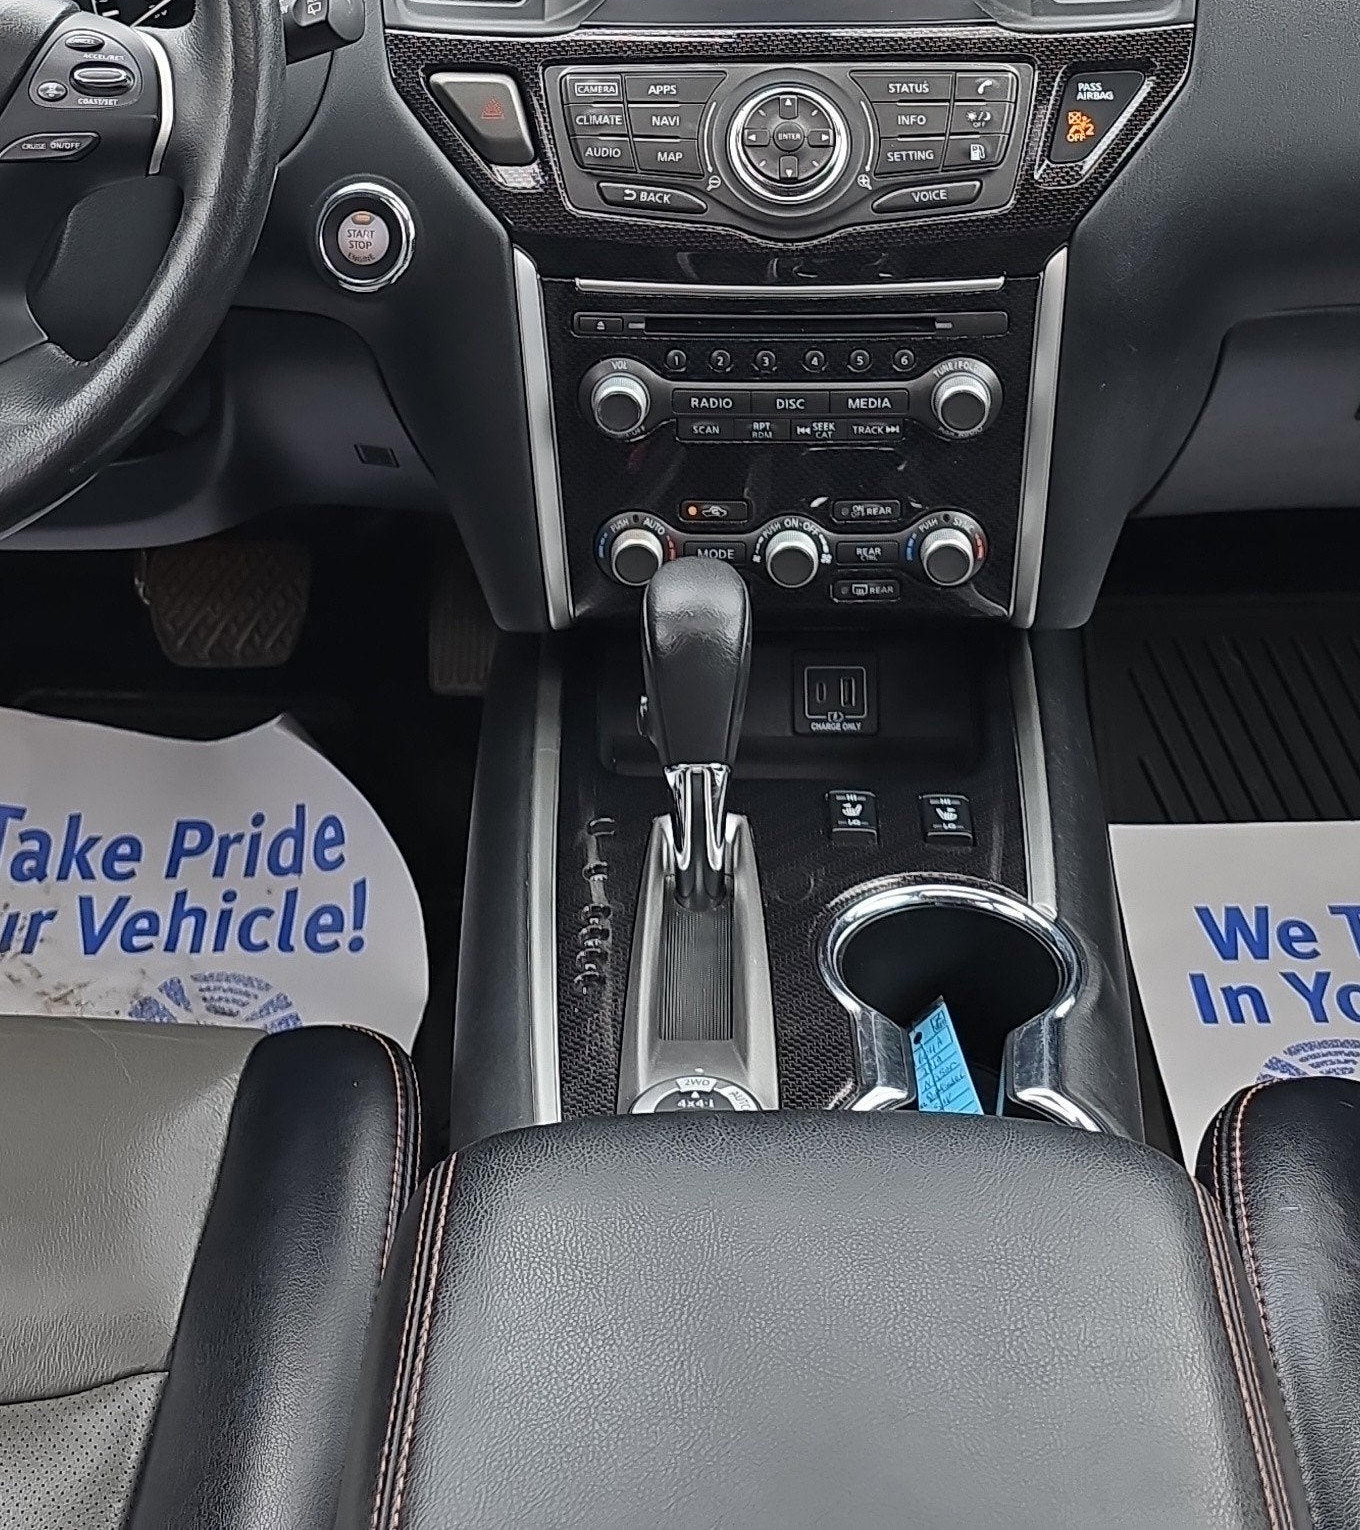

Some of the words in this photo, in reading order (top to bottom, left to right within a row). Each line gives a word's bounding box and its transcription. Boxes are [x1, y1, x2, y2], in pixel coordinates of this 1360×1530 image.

[577, 85, 615, 95] CAMERA
[648, 85, 677, 95] APPS
[888, 83, 929, 94] STATUS
[1077, 82, 1102, 91] PASS
[1076, 91, 1114, 101] AIRBAG
[576, 115, 622, 125] CLIMATE
[652, 116, 680, 126] NAVI
[897, 115, 926, 125] INFO
[778, 132, 801, 141] ENTER
[50, 142, 80, 150] ON/OFF
[585, 147, 621, 158] AUDIO
[657, 152, 683, 162] MAP
[887, 150, 934, 162] SETTING
[640, 192, 671, 204] BACK
[912, 190, 947, 202] VOICE
[347, 229, 375, 238] START
[349, 241, 372, 249] STOP
[611, 361, 627, 370] VOL
[674, 356, 679, 365] 1
[717, 356, 724, 366] 2
[763, 357, 770, 366] 3
[811, 356, 818, 366] 4
[857, 356, 863, 366] 5
[901, 356, 908, 366] 6
[690, 397, 733, 409] RADIO
[776, 398, 806, 409] DISC
[847, 397, 891, 409] MEDIA
[692, 425, 720, 434] SCAN
[752, 422, 770, 430] RPT
[812, 422, 835, 431] SEEK
[853, 425, 882, 435] TRACK
[815, 431, 832, 439] CAT
[866, 506, 892, 516] REAR
[610, 518, 629, 533] PUSH
[643, 518, 666, 535] AUTO
[762, 522, 781, 538] PUSH
[918, 518, 938, 532] PUSH
[697, 549, 734, 559] MODE
[856, 547, 881, 556] REAR
[869, 586, 894, 595] REAR
[811, 722, 841, 731] CHARGE
[842, 722, 862, 731] ONLY
[163, 803, 345, 880] Pride
[78, 877, 368, 957] Vehicle!
[1193, 904, 1321, 962] We
[1188, 971, 1271, 1026] In
